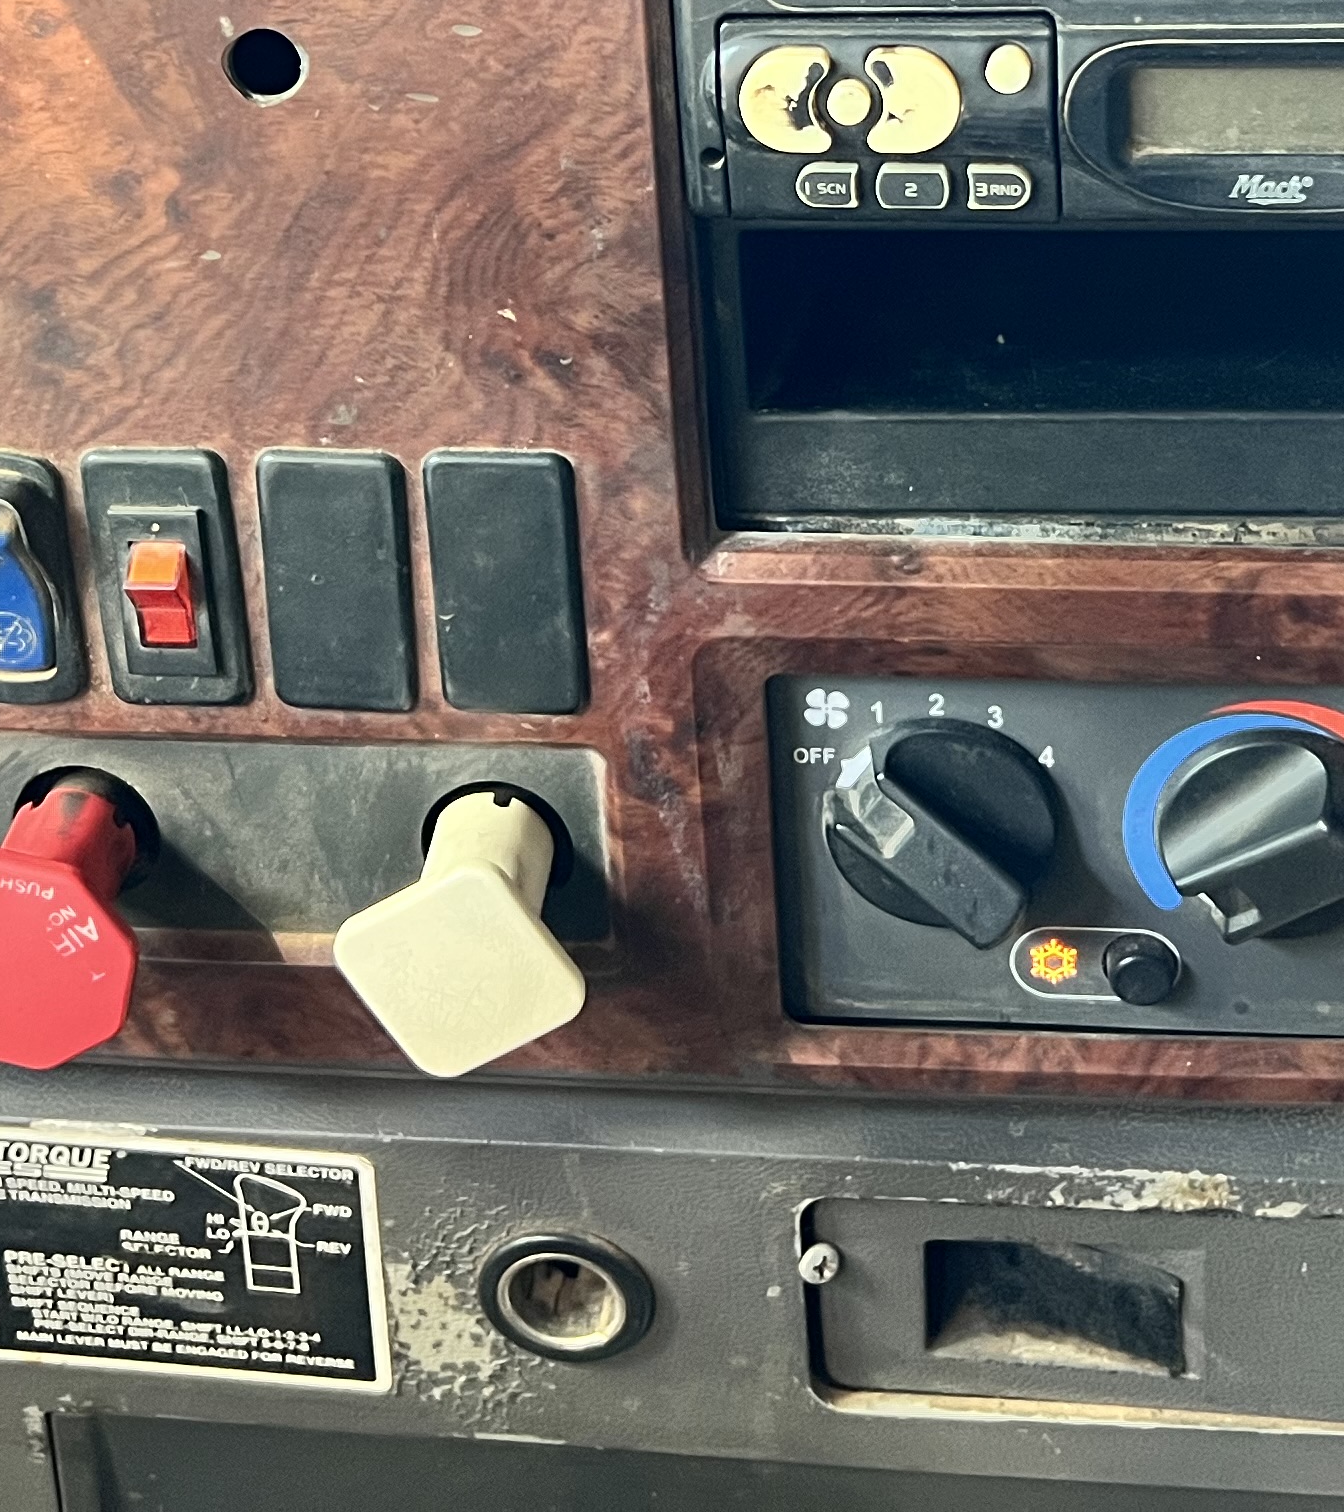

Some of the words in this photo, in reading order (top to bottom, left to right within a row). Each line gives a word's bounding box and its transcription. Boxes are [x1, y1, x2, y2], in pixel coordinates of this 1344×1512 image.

[816, 181, 847, 195] SCN
[904, 182, 918, 197] 2
[1228, 174, 1307, 205] Mack
[870, 701, 883, 724] 1
[927, 693, 945, 717] 2
[986, 704, 1004, 729] 3
[793, 746, 836, 766] OFF
[1037, 745, 1055, 768] 4
[0, 877, 55, 901] PUSH
[184, 1156, 261, 1174] FWD/REV
[264, 1162, 354, 1183] SELECTOR
[8, 1189, 132, 1211] TRANSMISSION
[67, 1181, 176, 1204] MULTI-SPEED
[206, 1212, 225, 1225] HI
[312, 1203, 353, 1219] FWD
[119, 1228, 180, 1246] RANGE
[206, 1227, 231, 1240] LO
[121, 1240, 212, 1260] SELECTOR
[316, 1240, 352, 1256] REV
[117, 1271, 174, 1288] RANGE
[136, 1264, 166, 1277] ALL
[167, 1266, 226, 1282] RANGE
[160, 1286, 225, 1303] MOVING
[10, 1296, 54, 1309] SHIFT
[56, 1300, 141, 1317] SEQUENCE
[31, 1308, 78, 1322] START
[16, 1330, 55, 1343] MAIN
[56, 1333, 106, 1348] LEVER
[107, 1337, 149, 1351] MUST
[151, 1341, 173, 1354] BE
[175, 1344, 249, 1360] ENGAGED
[251, 1350, 283, 1363] FOR
[285, 1353, 356, 1370] REVERSE
